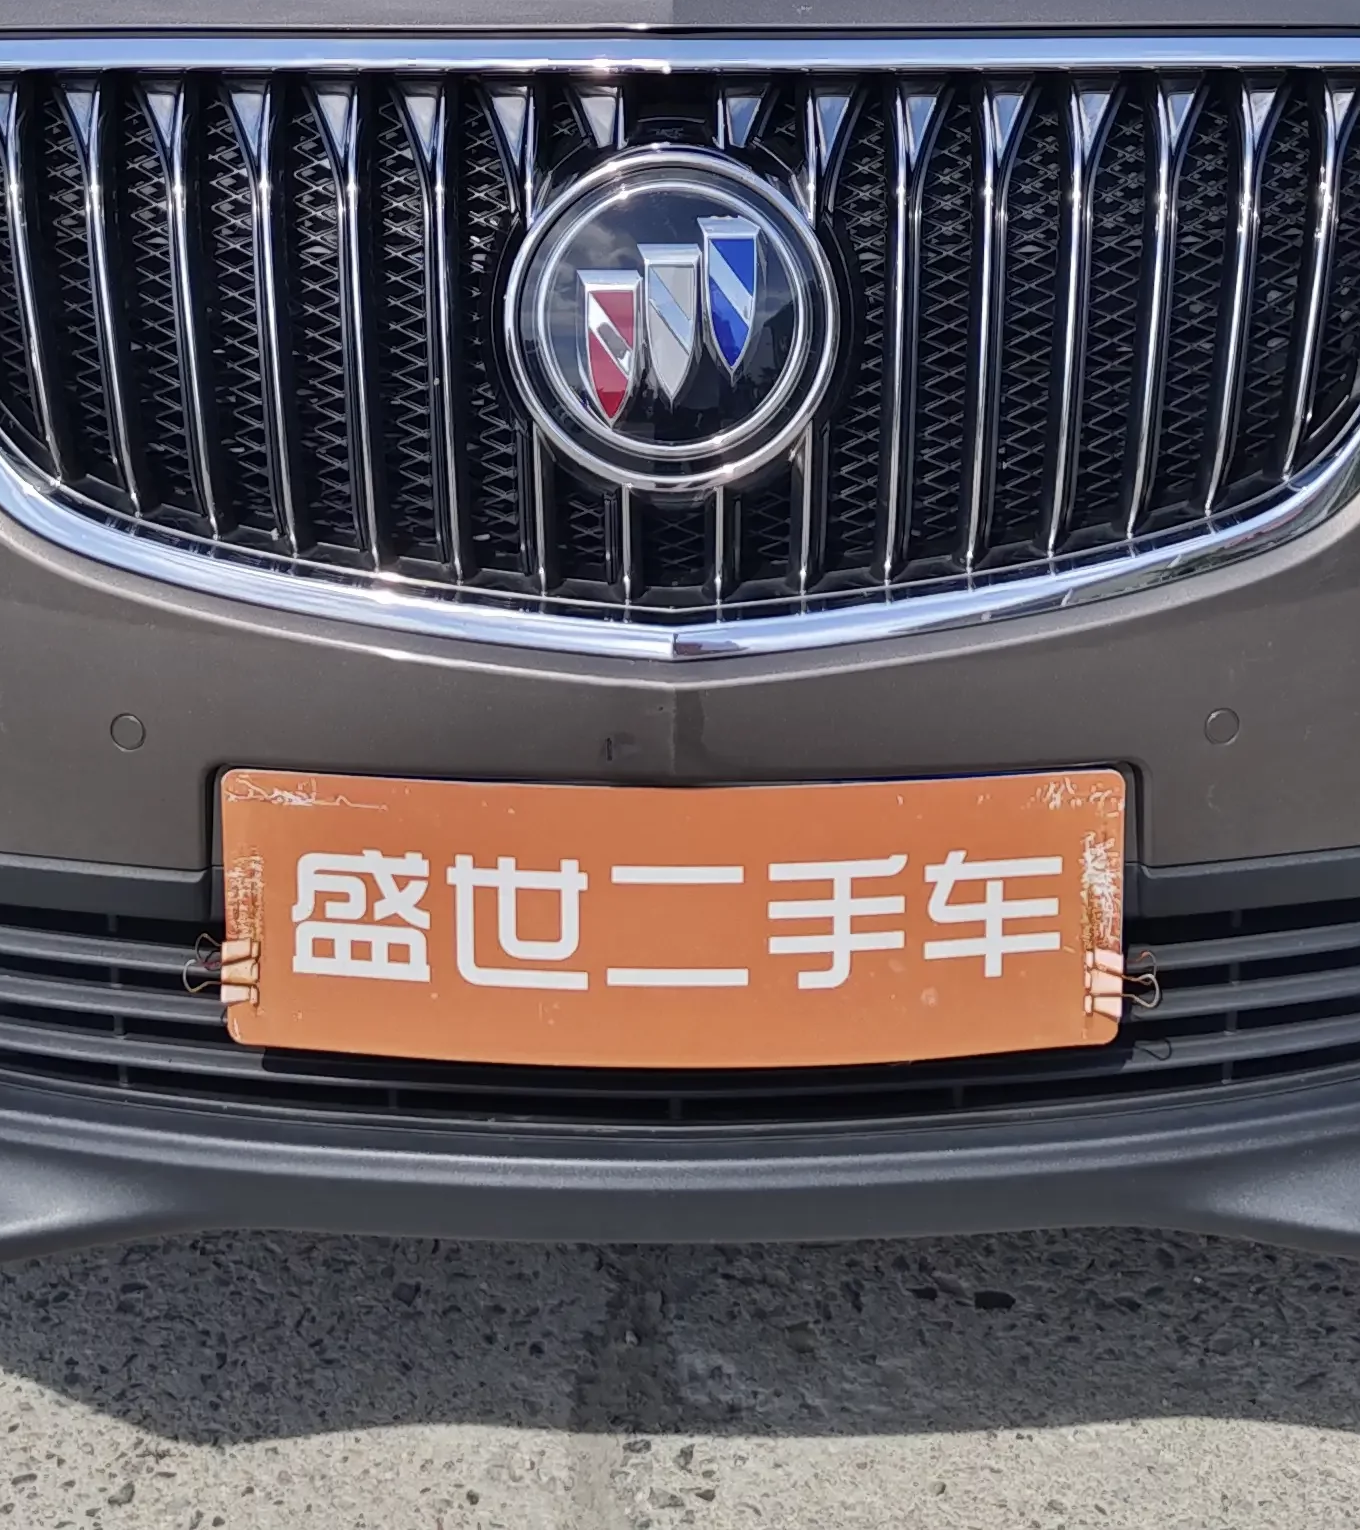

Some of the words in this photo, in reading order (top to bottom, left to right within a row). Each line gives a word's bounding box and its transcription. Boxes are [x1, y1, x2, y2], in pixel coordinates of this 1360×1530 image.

[292, 851, 1061, 989] 盛世二手车
